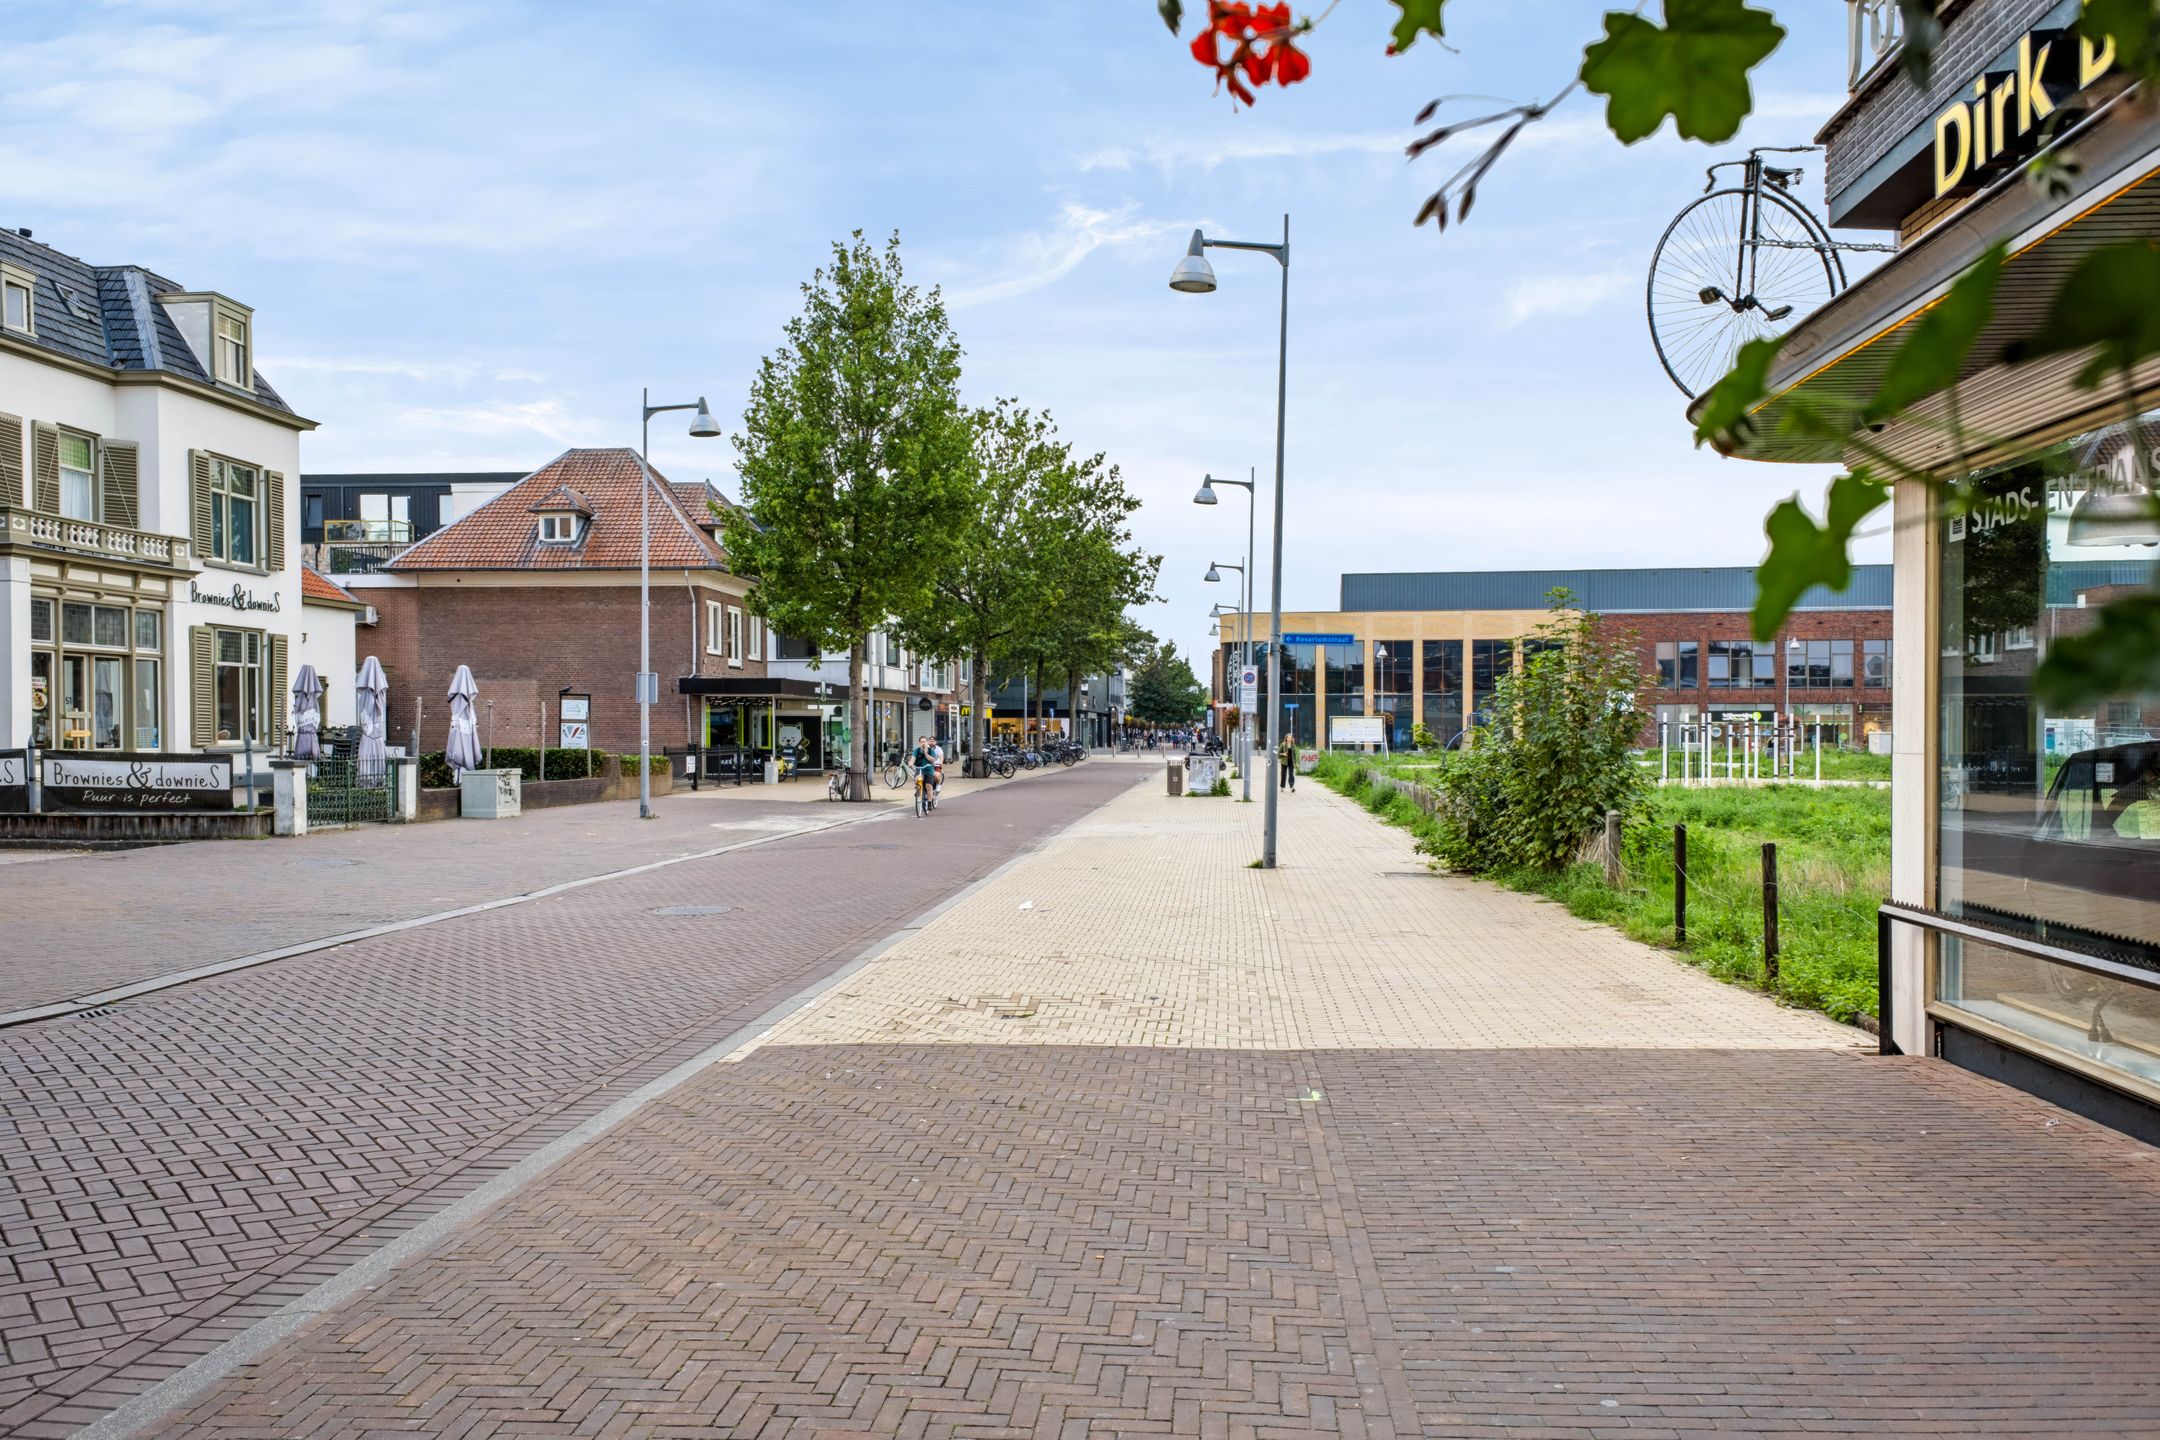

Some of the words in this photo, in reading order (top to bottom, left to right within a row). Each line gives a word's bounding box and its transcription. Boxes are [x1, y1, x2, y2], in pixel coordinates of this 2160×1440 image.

[1934, 29, 2056, 200] Dirk
[1971, 486, 2040, 533] STADS-
[53, 762, 124, 786] Brownies
[82, 790, 115, 803] Puur
[123, 791, 134, 803] is
[140, 791, 192, 807] perfect
